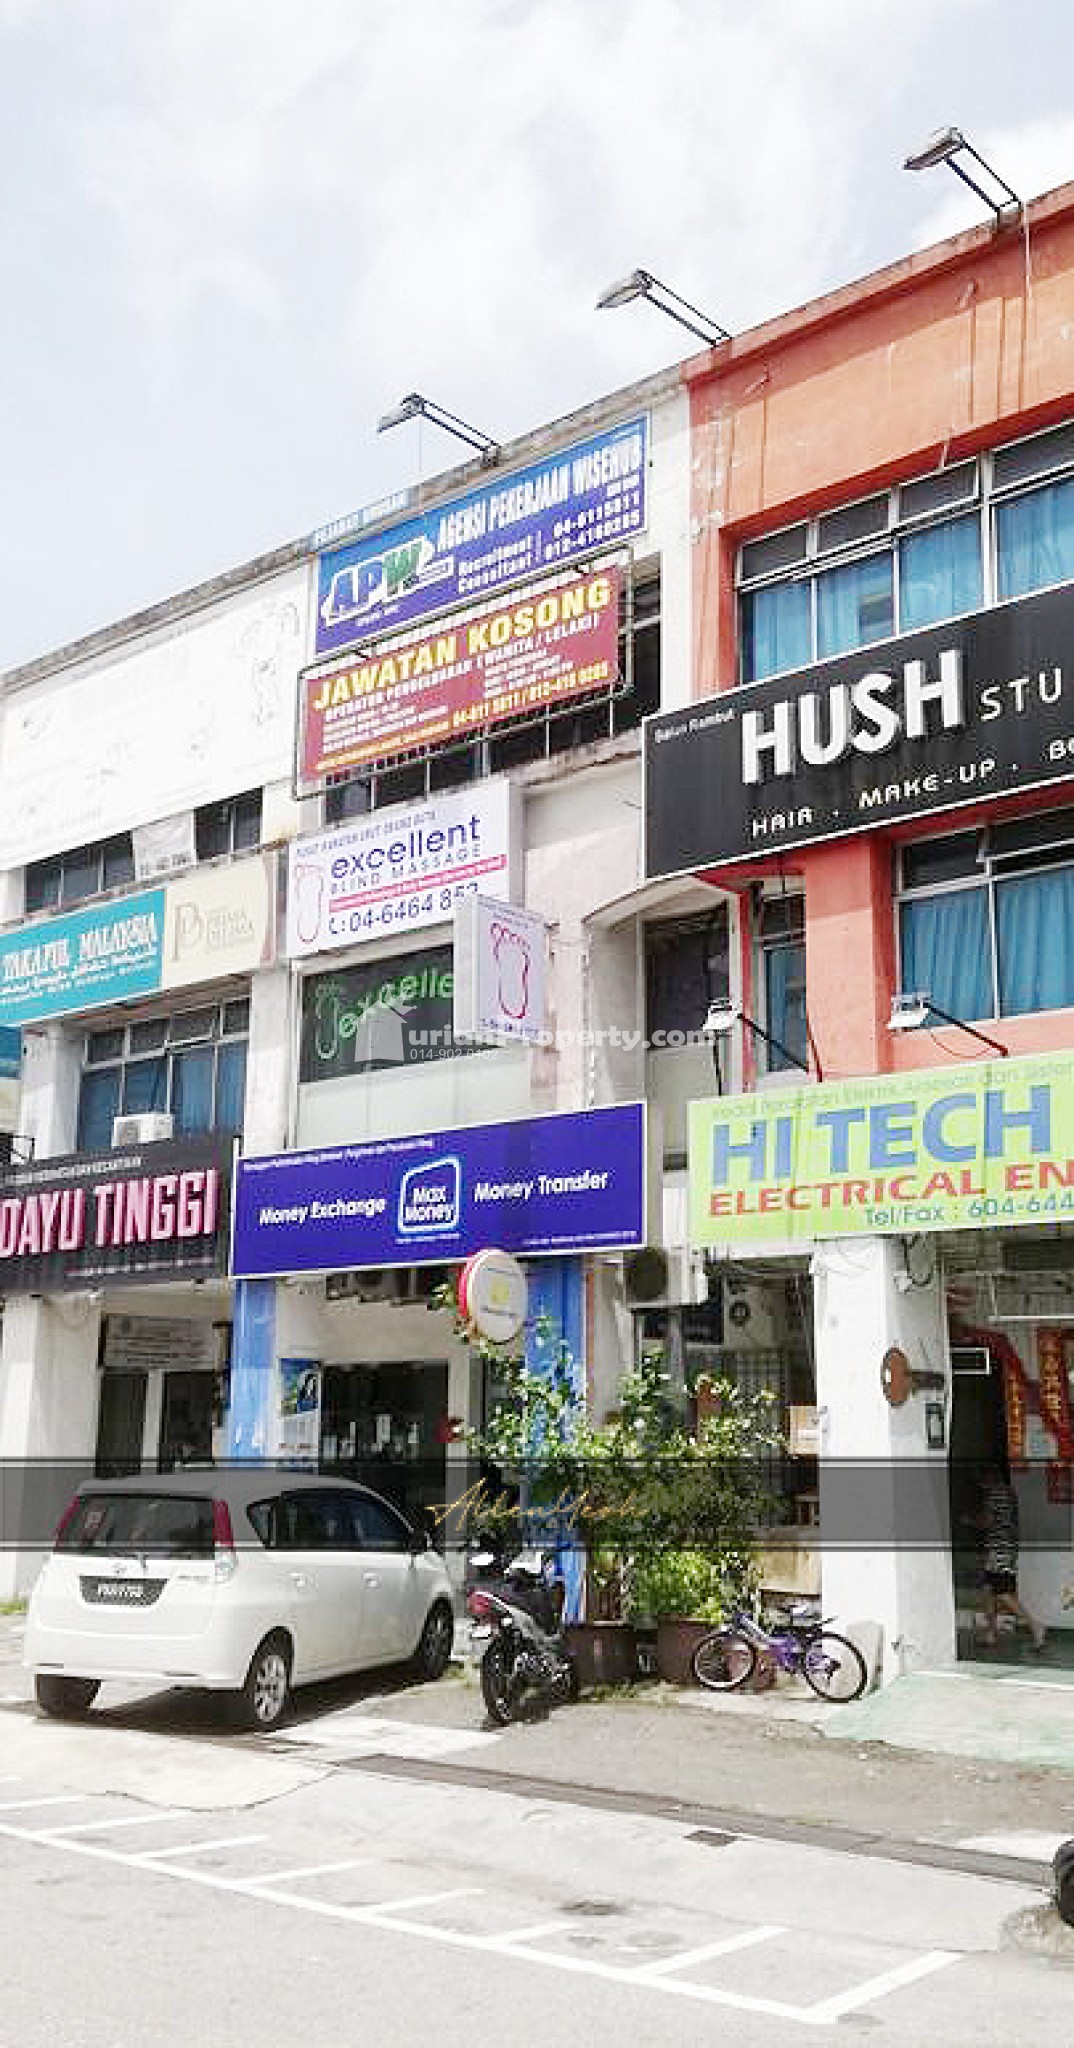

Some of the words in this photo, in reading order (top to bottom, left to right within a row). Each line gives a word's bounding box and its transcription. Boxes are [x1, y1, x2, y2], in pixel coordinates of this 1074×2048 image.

[438, 499, 486, 552] AGENSI
[489, 464, 568, 531] PEKERJAAN
[325, 540, 424, 621] APW
[458, 536, 531, 575] Recruitment
[458, 554, 531, 593] Consultant
[315, 636, 458, 709] JAWATAN
[467, 578, 609, 653] KOSONG
[325, 691, 384, 722] OPERATOR
[742, 649, 965, 784] HUSH
[980, 667, 1062, 721] STU
[752, 807, 813, 837] HAIR
[859, 760, 996, 808] MAKE-UP
[331, 814, 481, 879] excellent
[331, 866, 381, 894] BLIND
[392, 843, 481, 882] MASSAGE
[3, 936, 70, 981] TAKAFUL
[80, 912, 158, 966] MALAYSIA
[712, 1117, 793, 1187] HI
[816, 1085, 1051, 1174] TECH
[94, 1169, 220, 1247] TINGGI
[259, 1206, 307, 1225] Money
[310, 1197, 388, 1220] Exchange
[405, 1203, 454, 1223] Money
[413, 1185, 447, 1204] Max
[475, 1179, 534, 1203] Money
[538, 1170, 608, 1196] Transfer
[709, 1170, 985, 1217] ELECTRICAL
[1005, 1162, 1074, 1192] EN
[865, 1206, 944, 1228] Tel/Fax
